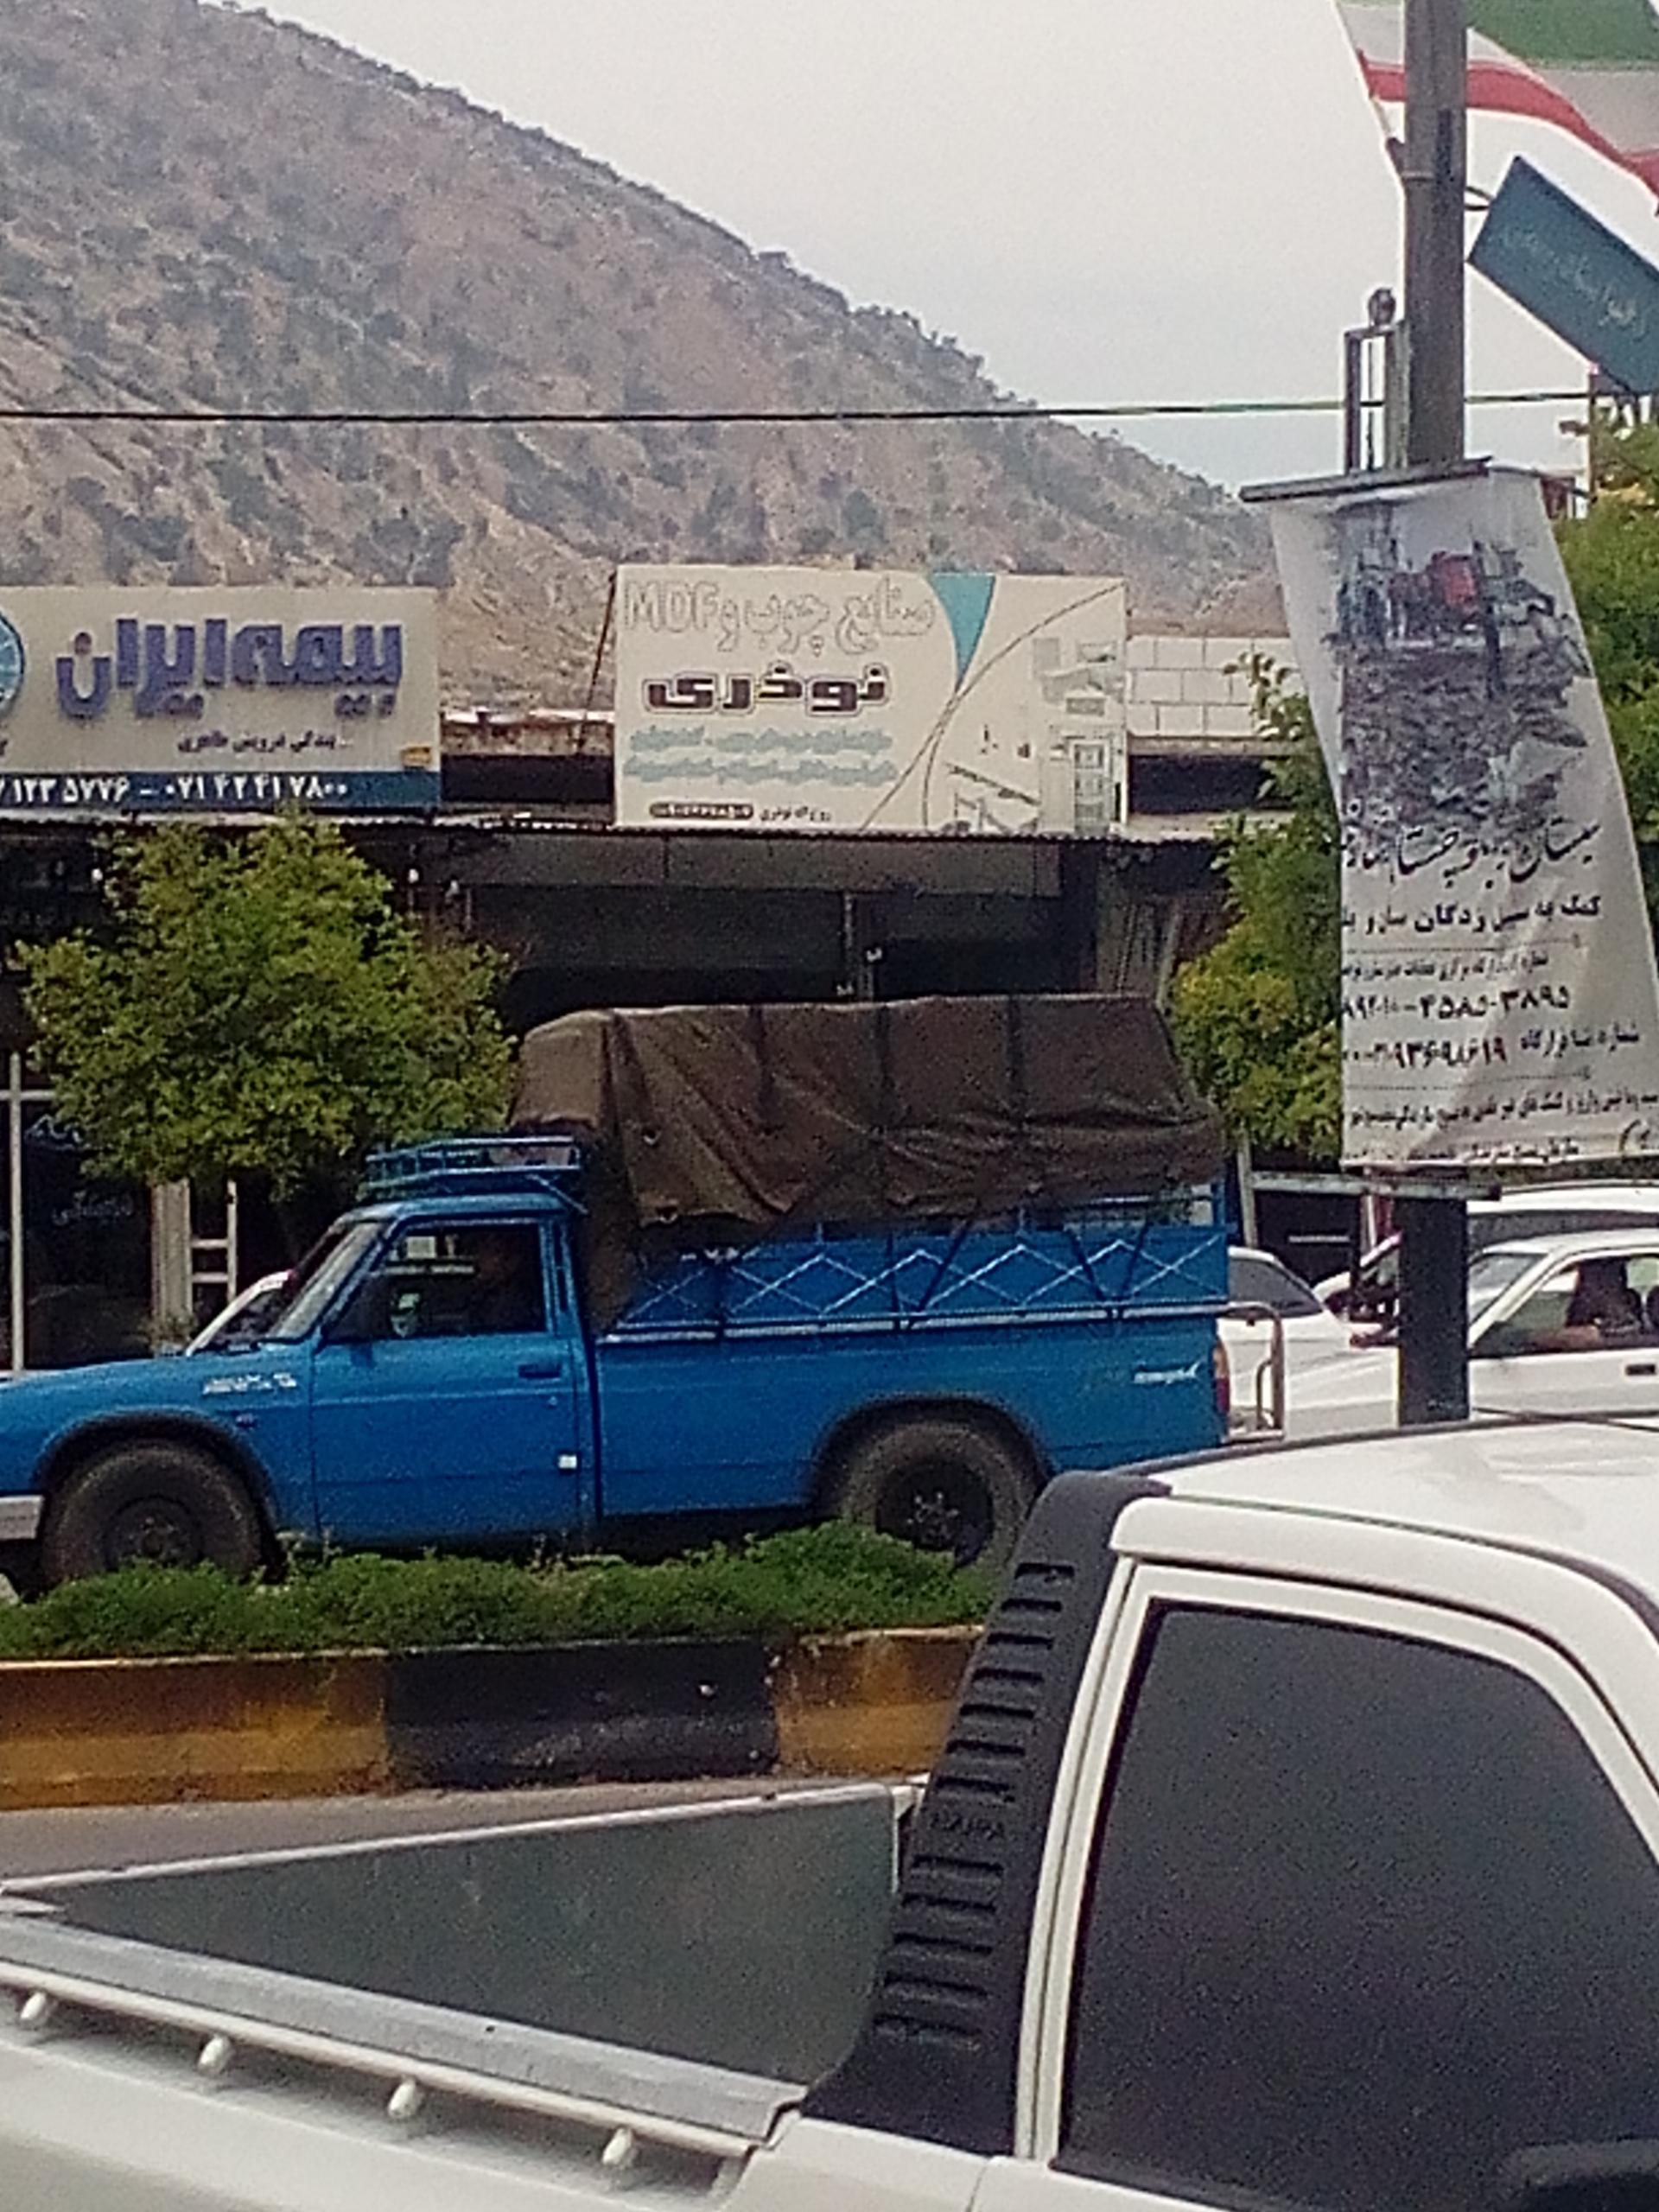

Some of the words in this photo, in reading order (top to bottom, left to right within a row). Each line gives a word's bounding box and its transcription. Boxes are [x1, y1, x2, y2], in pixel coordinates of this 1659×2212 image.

[624, 580, 720, 632] MDF
[717, 598, 741, 653] و
[743, 593, 830, 657] چوب
[835, 576, 936, 654] صنایع
[55, 617, 227, 721] ایران
[231, 623, 403, 719] بیمه
[645, 662, 888, 714] نوذری
